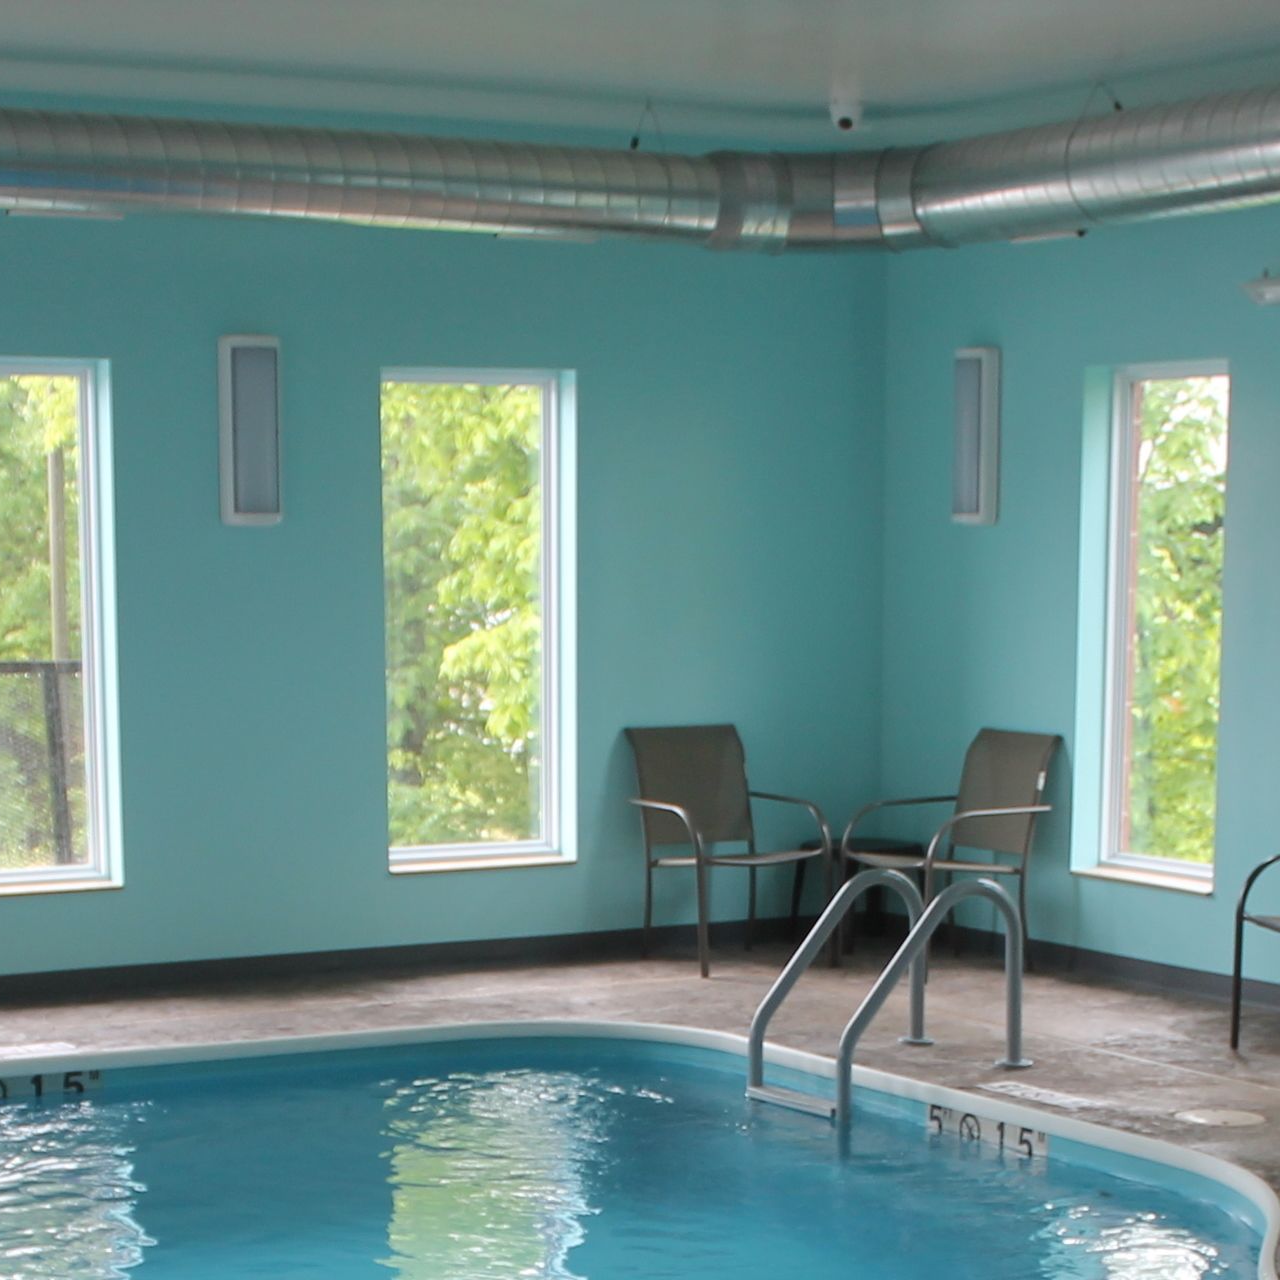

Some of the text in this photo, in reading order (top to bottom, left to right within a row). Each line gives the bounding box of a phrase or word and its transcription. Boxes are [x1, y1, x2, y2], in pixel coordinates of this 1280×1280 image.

[929, 1104, 943, 1134] 5
[996, 1121, 1005, 1149] 1
[1019, 1127, 1033, 1157] 5
